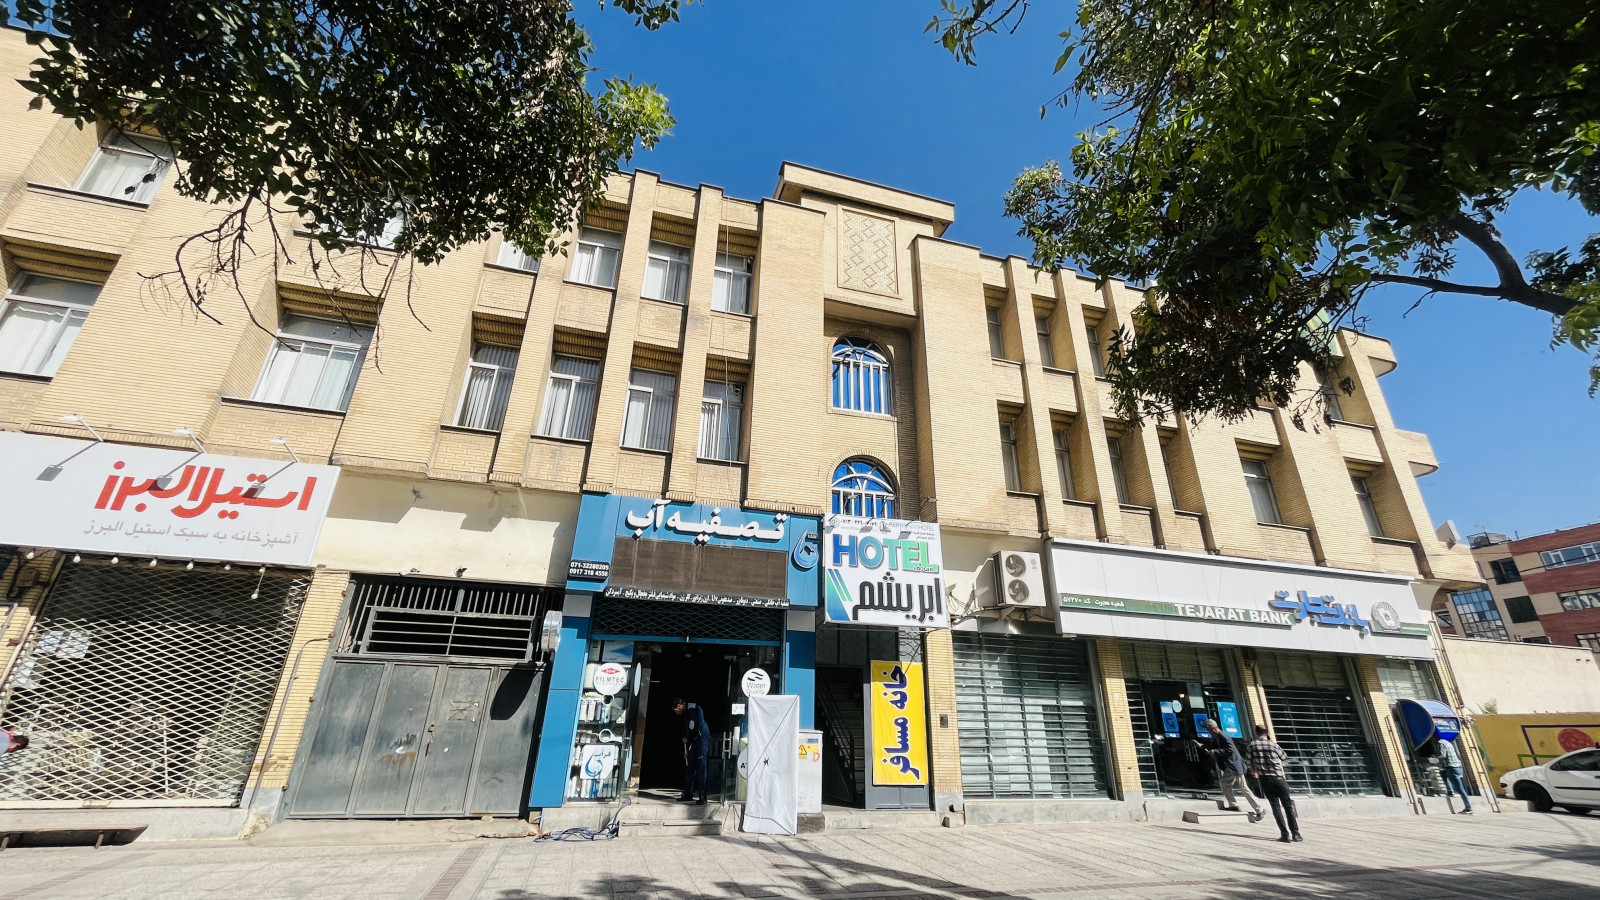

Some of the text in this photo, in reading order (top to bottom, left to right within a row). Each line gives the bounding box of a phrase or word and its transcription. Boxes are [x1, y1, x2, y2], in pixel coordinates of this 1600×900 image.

[94, 460, 318, 520] استیل البرز
[83, 519, 299, 548] آشپزخانه به سبک استیل البرز
[625, 498, 789, 544] تصفیه آب
[832, 533, 940, 574] HOTEL
[852, 571, 943, 623] ابریشم
[1174, 603, 1293, 626] TEJARAT BANK
[881, 664, 920, 781] خانه مسافر
